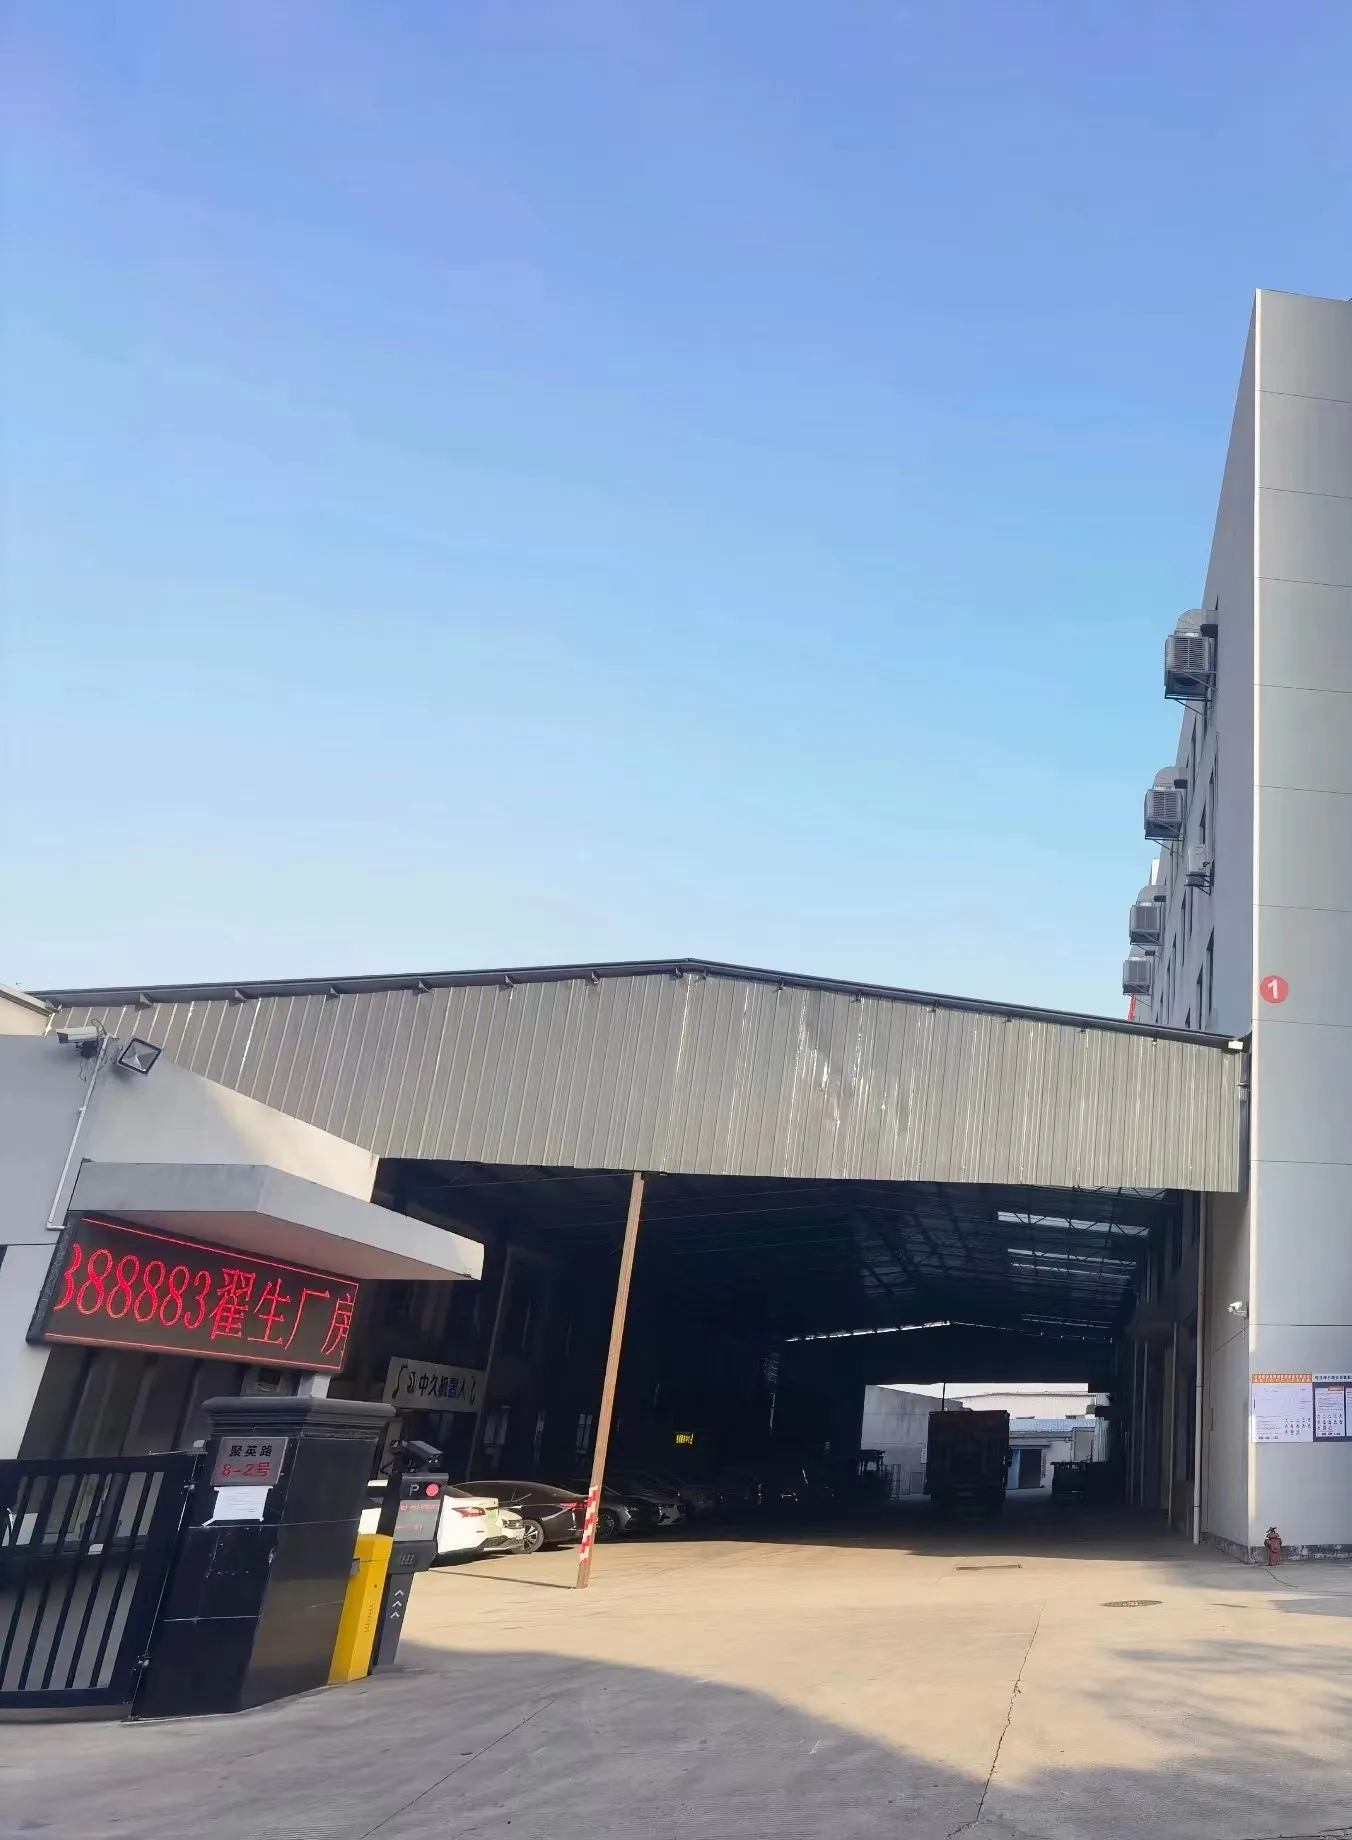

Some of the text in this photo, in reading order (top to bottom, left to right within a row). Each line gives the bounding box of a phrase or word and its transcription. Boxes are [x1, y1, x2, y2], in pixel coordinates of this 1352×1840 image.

[1267, 979, 1279, 1000] 1
[229, 1444, 273, 1457] 聚英路
[221, 1461, 271, 1477] 8-2号
[409, 1483, 420, 1496] P
